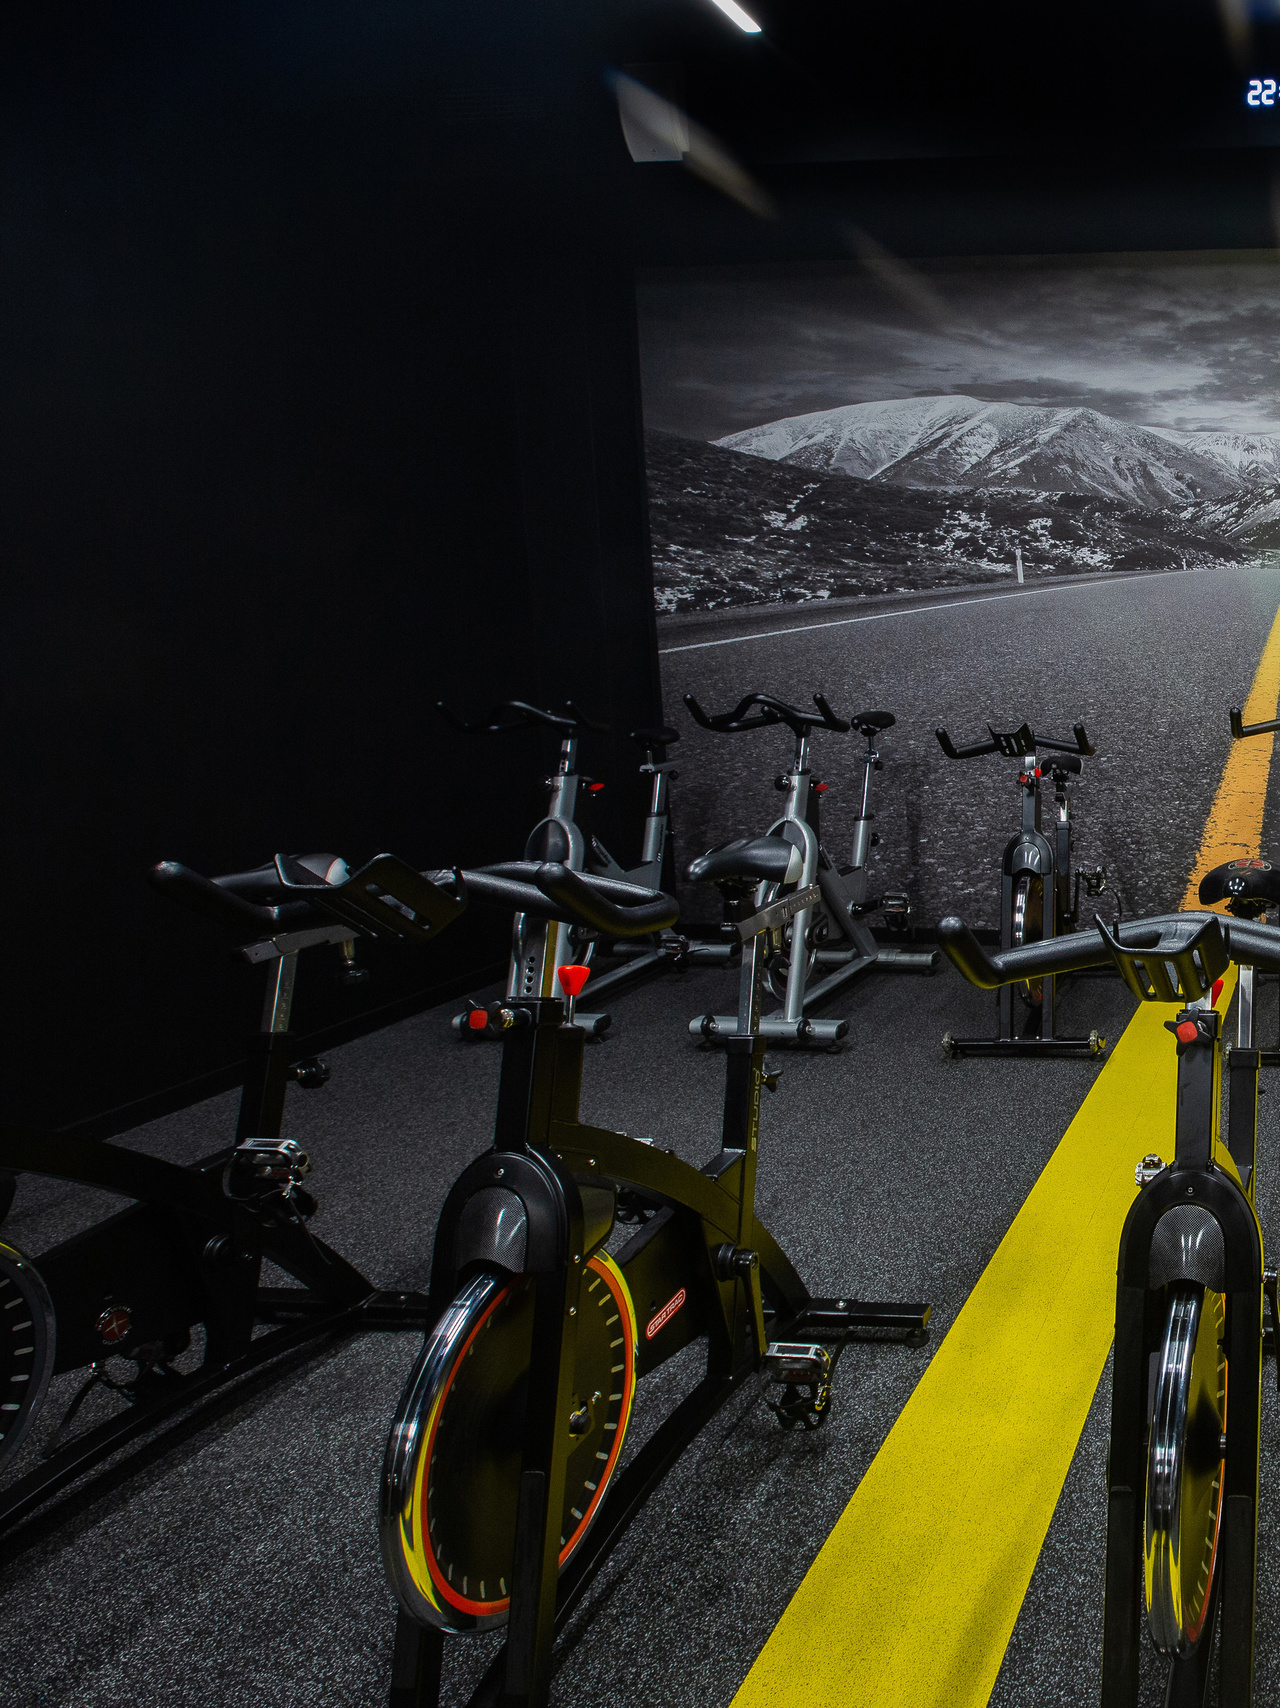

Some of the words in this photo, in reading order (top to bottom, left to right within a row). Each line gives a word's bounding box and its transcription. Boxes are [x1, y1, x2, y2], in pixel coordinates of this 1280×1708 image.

[751, 1070, 760, 1152] STUDIO
[649, 1311, 667, 1331] STAR
[666, 1293, 683, 1315] TRAC
